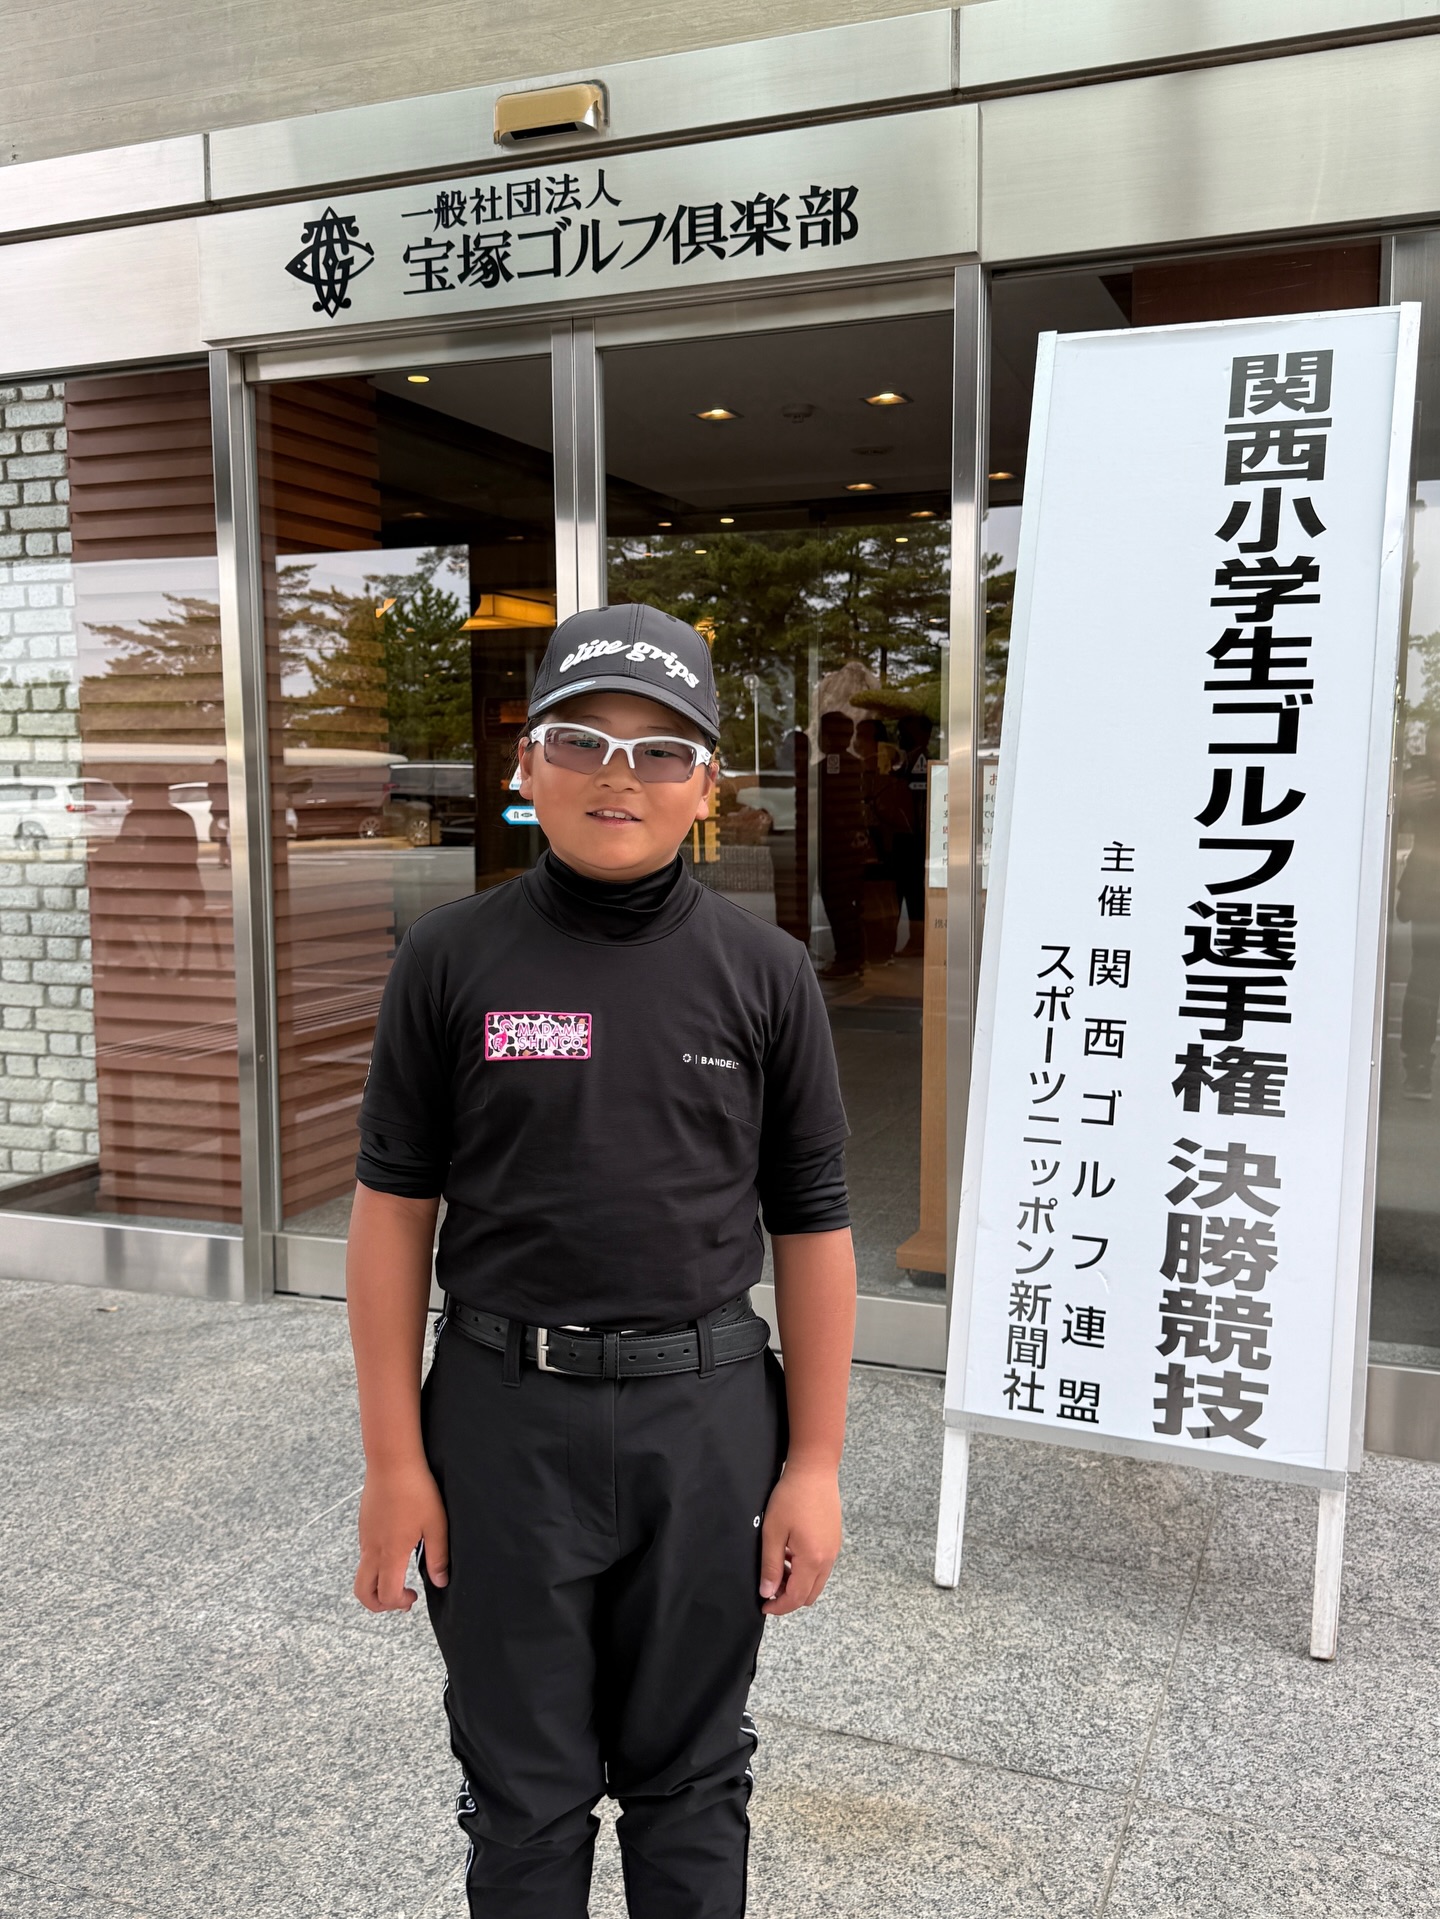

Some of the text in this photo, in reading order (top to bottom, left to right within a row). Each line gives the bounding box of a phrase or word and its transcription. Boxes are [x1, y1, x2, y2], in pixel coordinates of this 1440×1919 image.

[401, 169, 621, 231] 一般社団法人
[403, 185, 858, 295] 宝塚ゴルフ倶楽部
[560, 639, 699, 688] elite grips
[1153, 350, 1333, 1449] 関西小学生ゴルフ選手権 決勝競技
[518, 1024, 585, 1036] MADAME
[518, 1037, 583, 1050] SHINCO
[1057, 841, 1135, 1424] 主催 関西ゴルフ連盟
[1003, 945, 1074, 1413] スポーツニッポン新聞社
